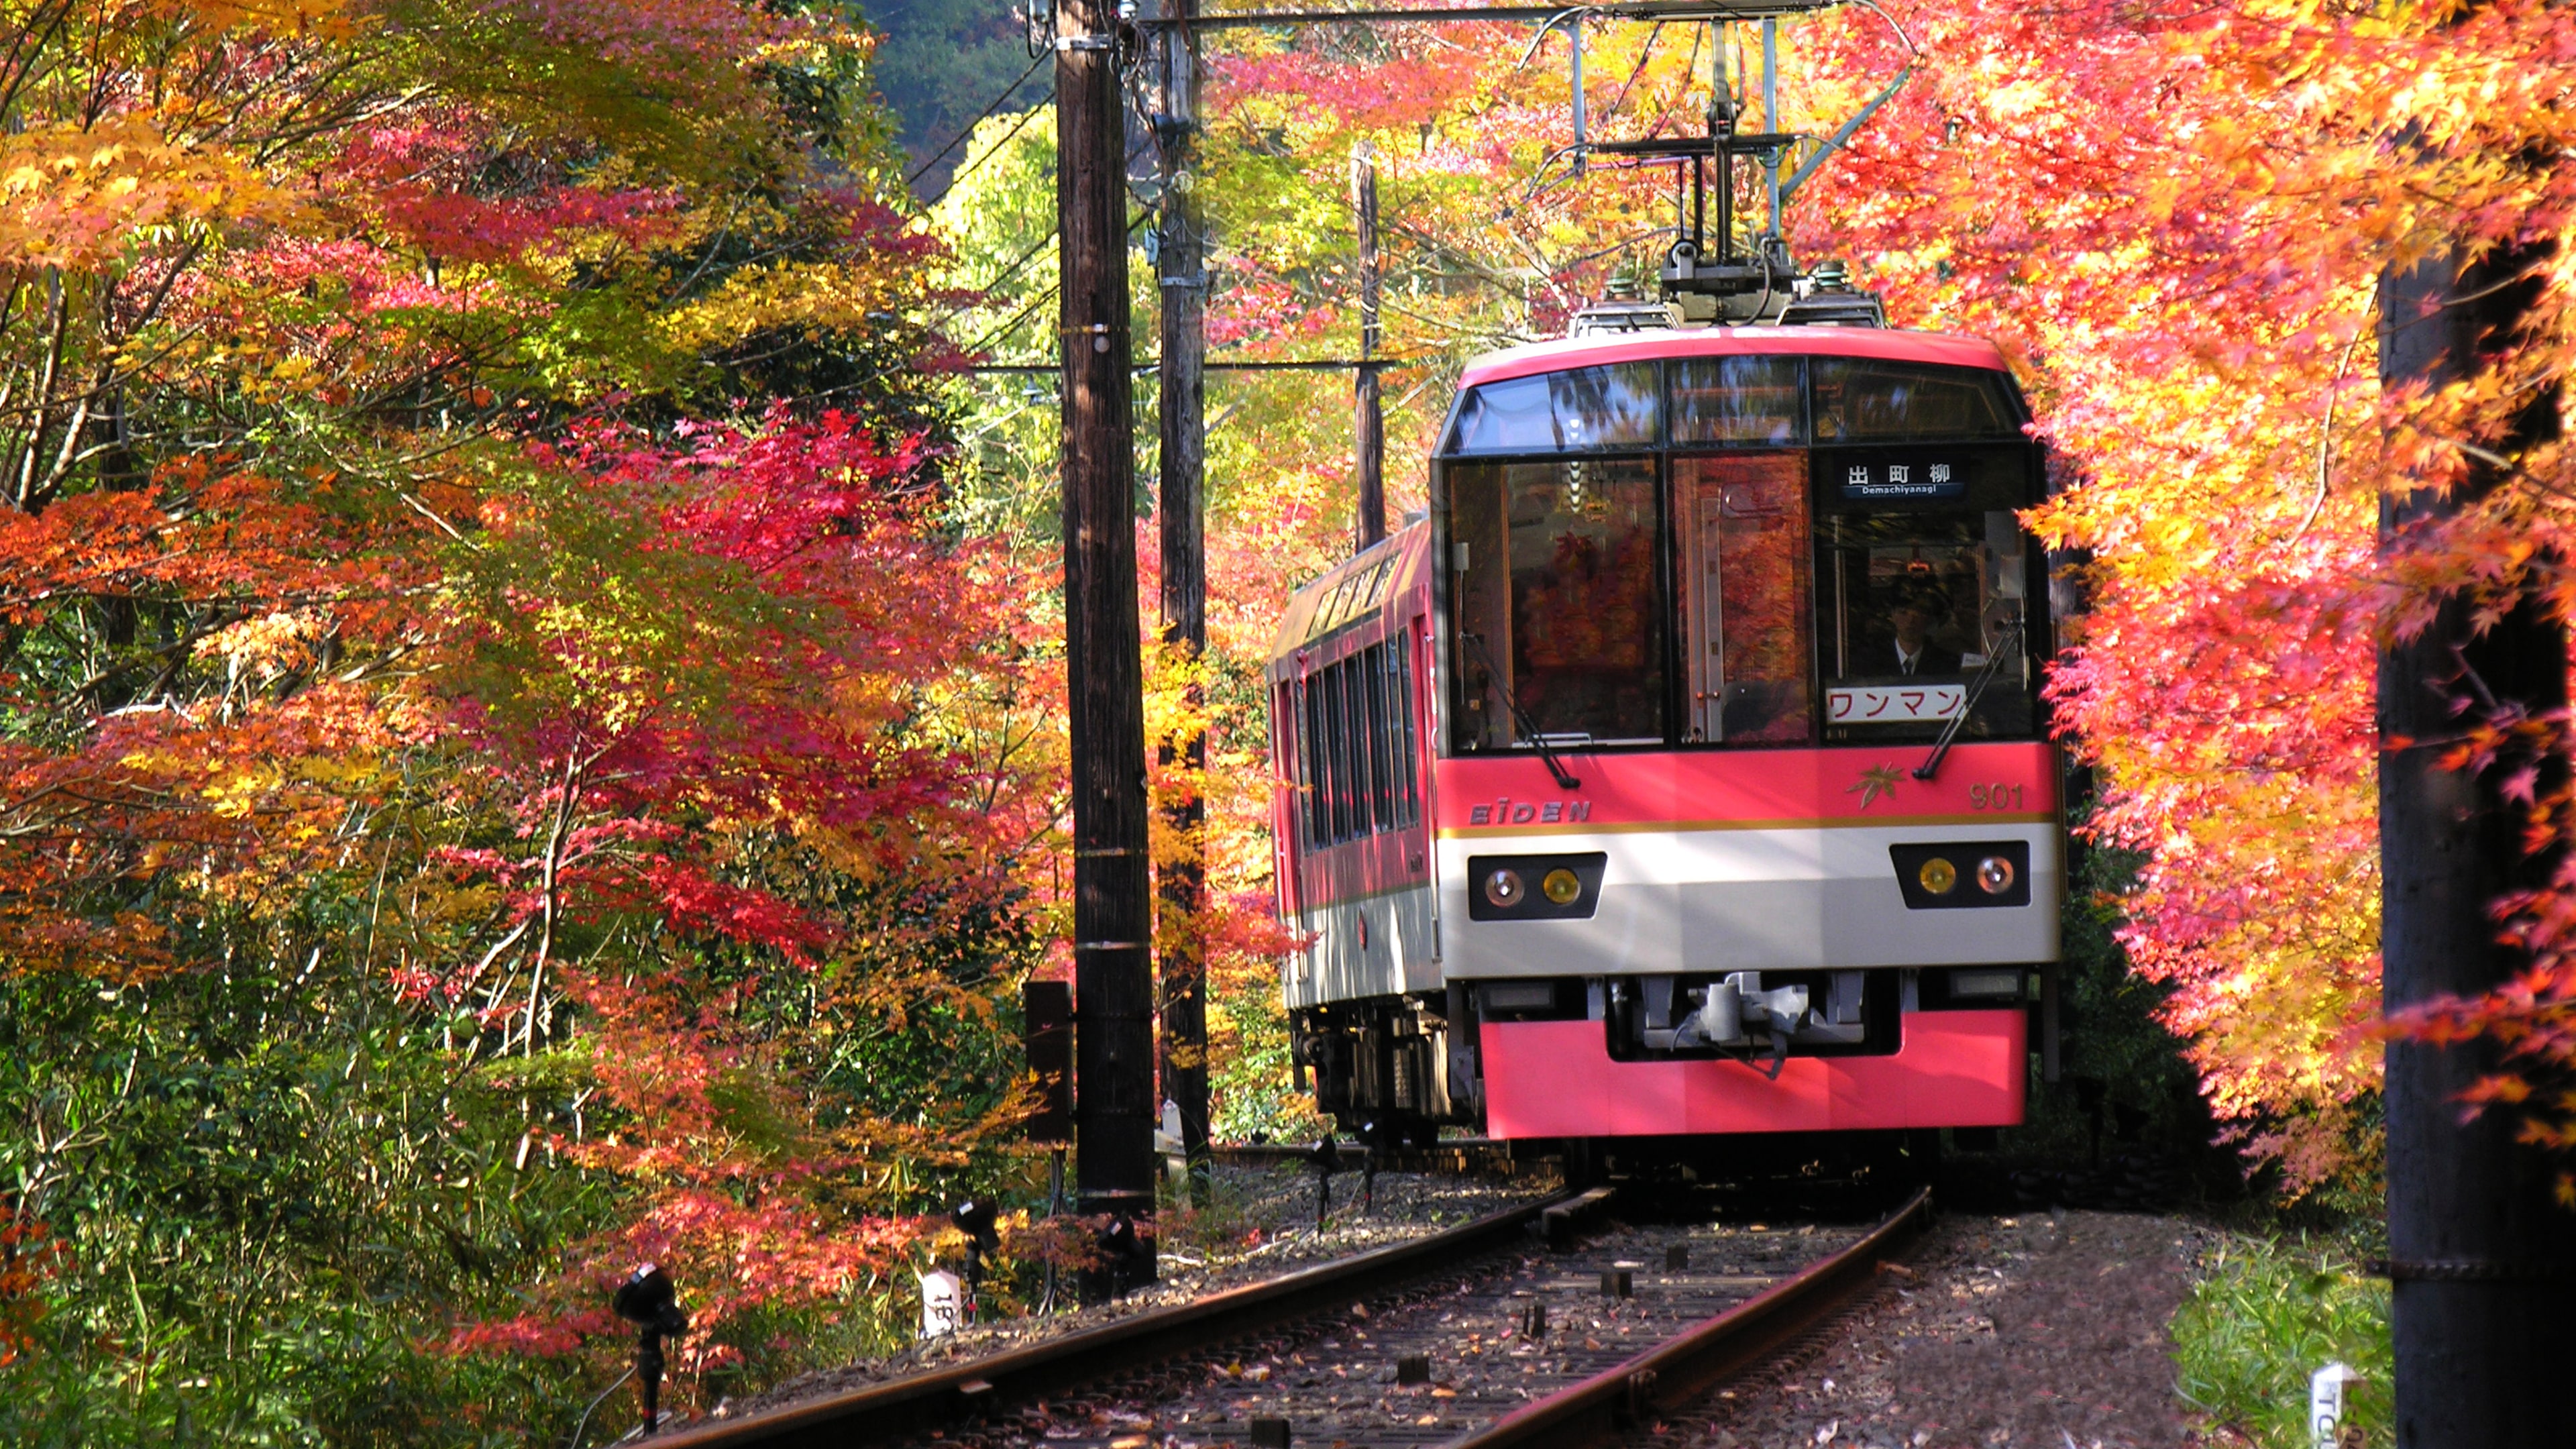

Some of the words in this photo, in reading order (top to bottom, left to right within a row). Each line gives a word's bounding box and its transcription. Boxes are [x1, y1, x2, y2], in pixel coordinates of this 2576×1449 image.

[1848, 464, 1949, 485] 出町柳
[1862, 485, 1937, 495] Demachiyanagi
[1829, 691, 1960, 718] ワンマン
[1970, 782, 2022, 809] 901
